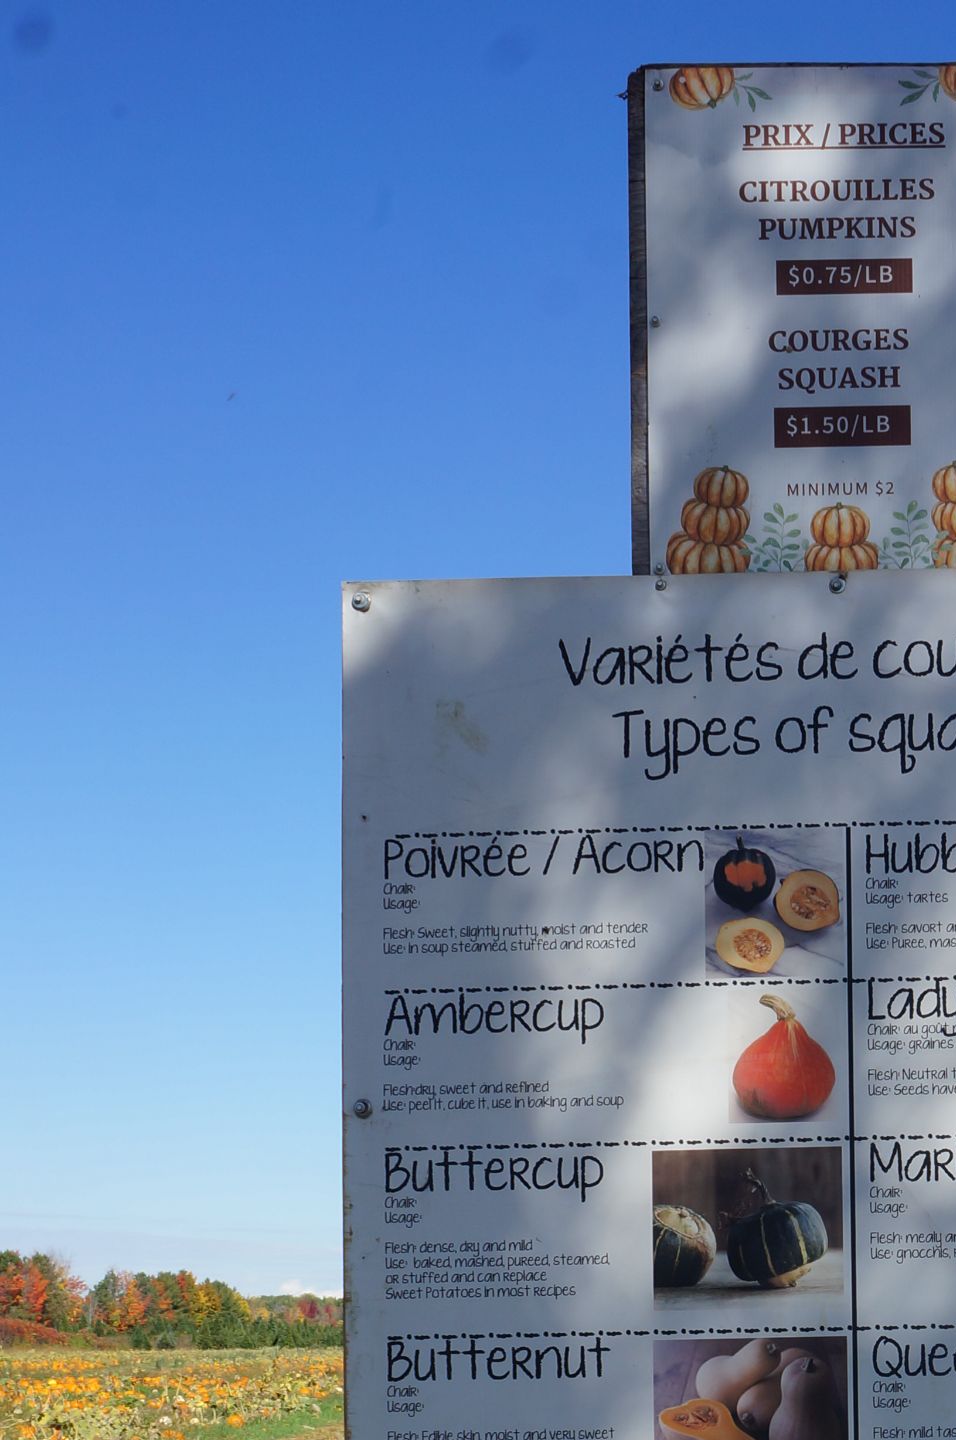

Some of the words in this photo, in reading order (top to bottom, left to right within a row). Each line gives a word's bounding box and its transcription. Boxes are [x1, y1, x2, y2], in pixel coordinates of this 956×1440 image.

[743, 124, 814, 146] PRIX
[838, 122, 945, 145] PRICES
[739, 178, 935, 203] CITROUILLES
[758, 216, 916, 240] PUMPKINS
[788, 265, 893, 287] $0.75/LB
[768, 328, 909, 353] COURGES
[778, 366, 901, 394] SQUASH
[786, 414, 891, 437] $1.50/LB
[787, 482, 868, 496] MINIMUM
[875, 481, 895, 496] $2
[798, 632, 858, 680] de
[612, 709, 761, 781] Types
[775, 706, 834, 754] of
